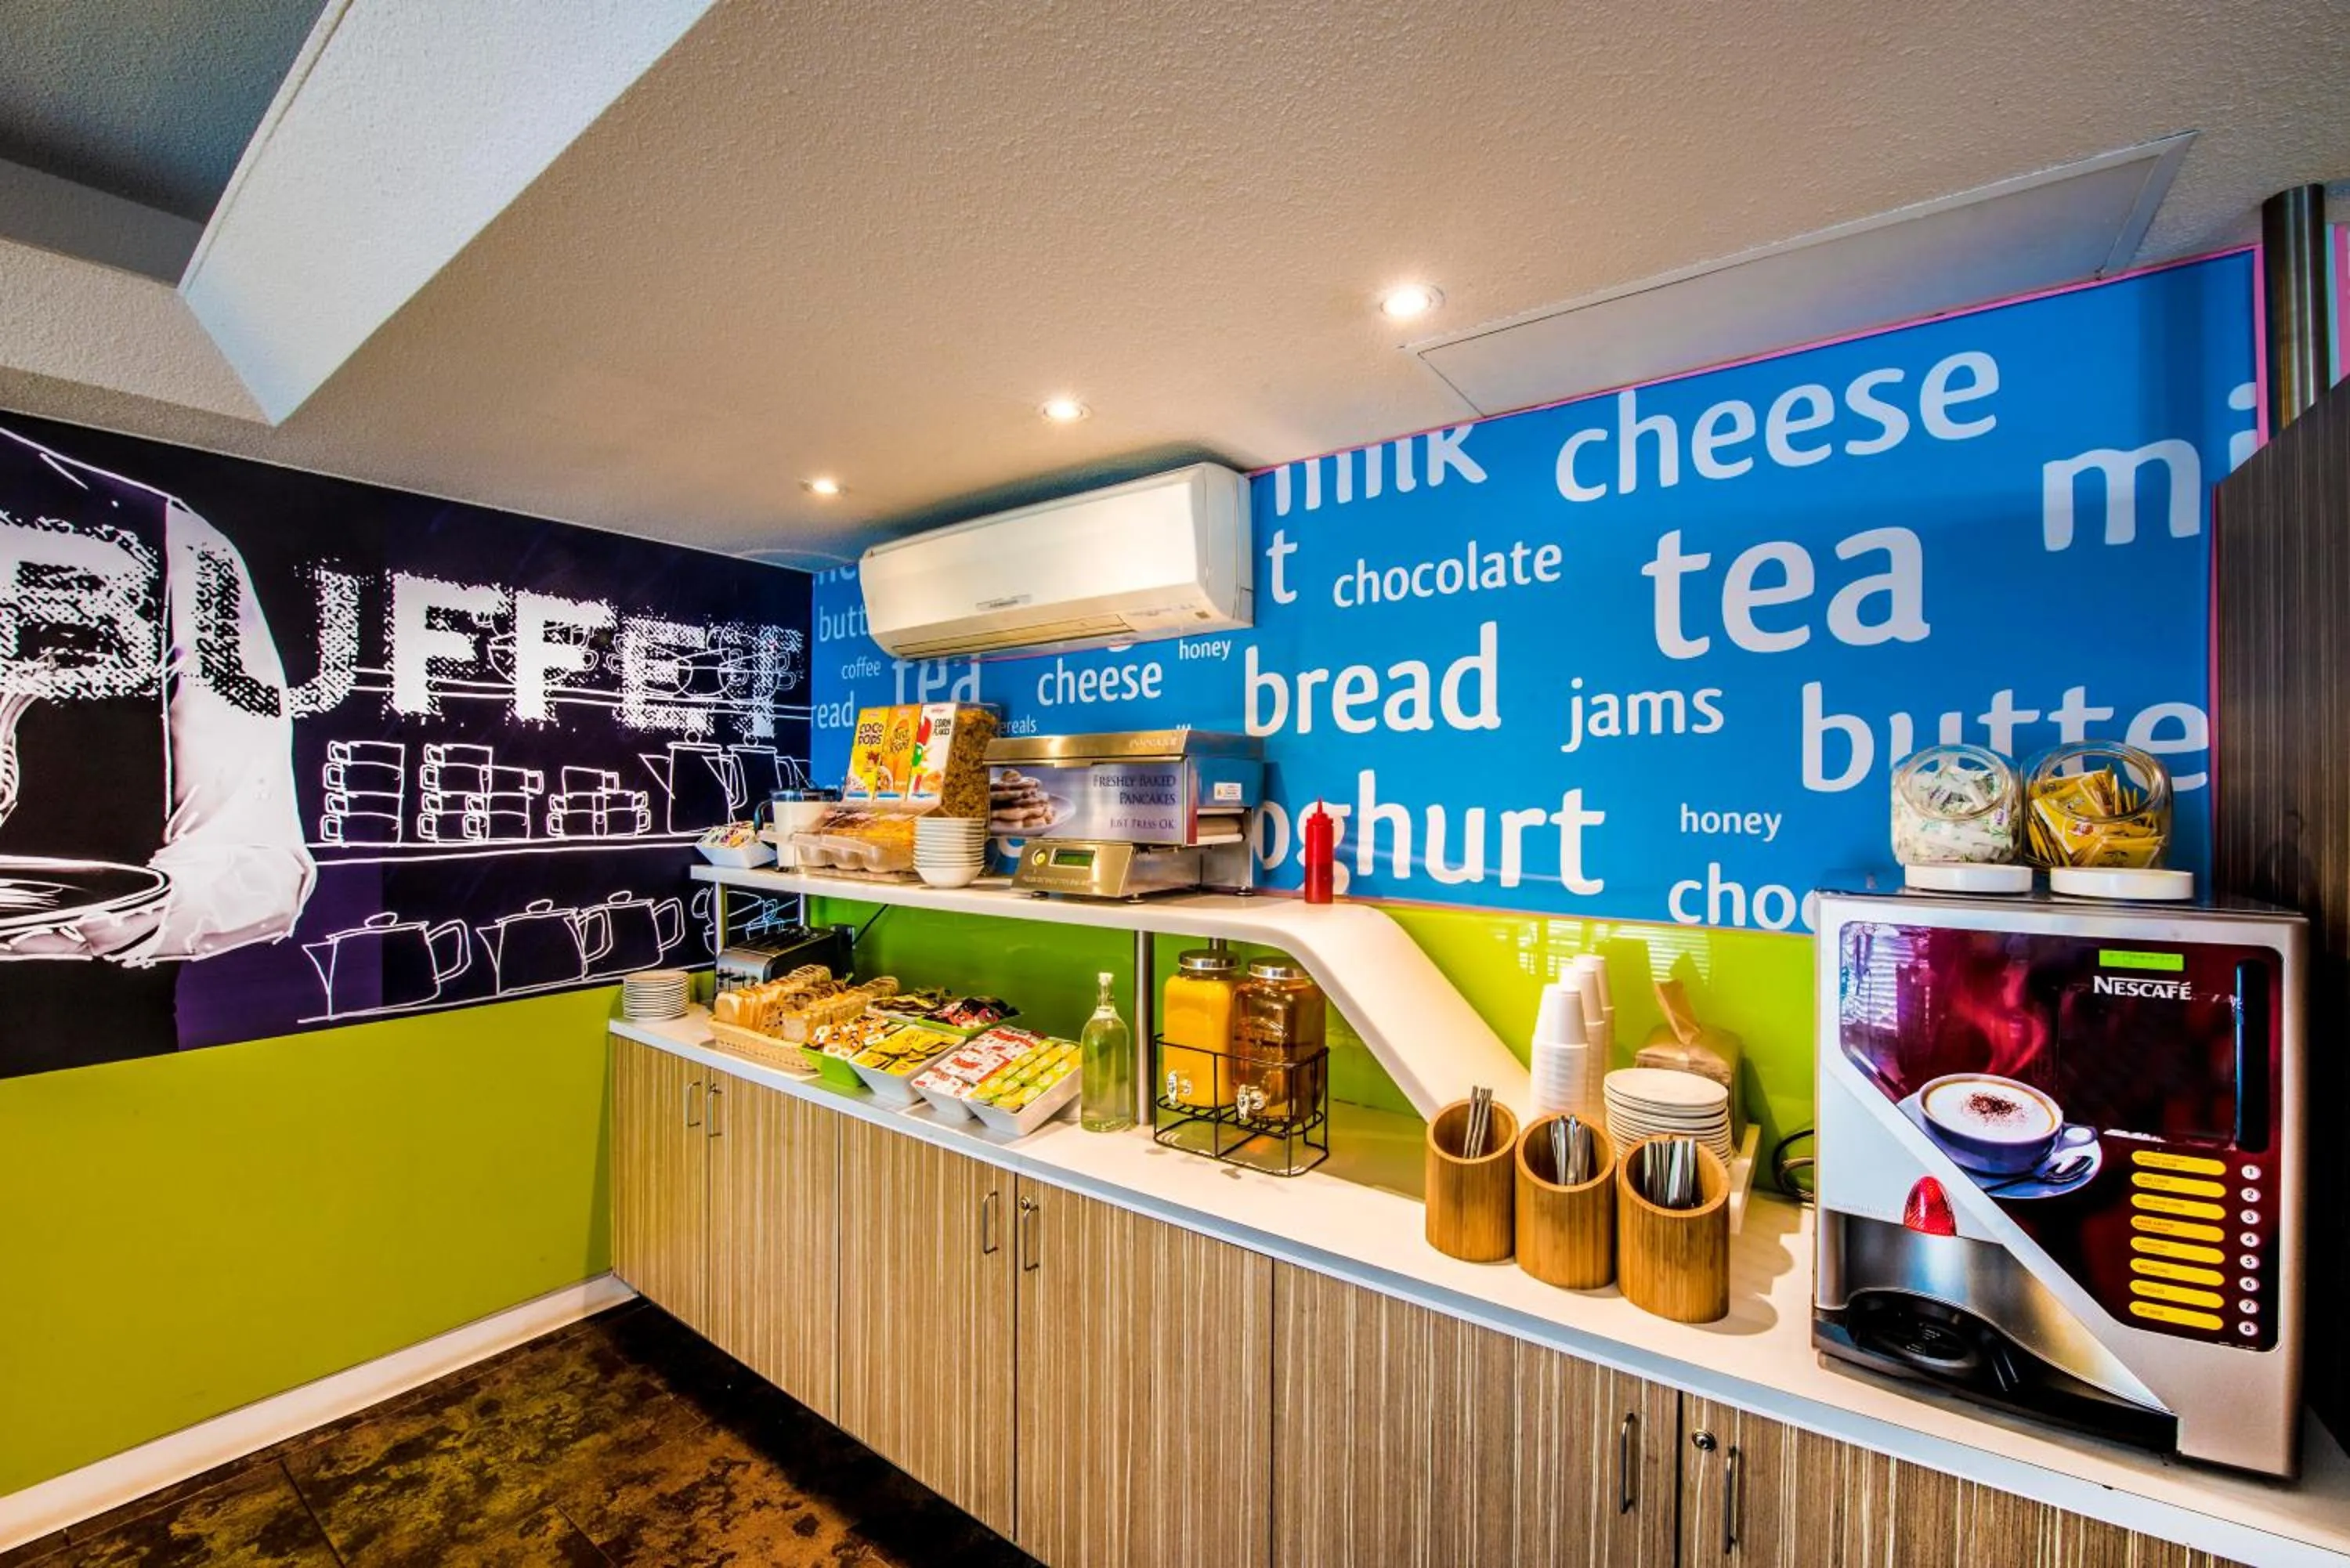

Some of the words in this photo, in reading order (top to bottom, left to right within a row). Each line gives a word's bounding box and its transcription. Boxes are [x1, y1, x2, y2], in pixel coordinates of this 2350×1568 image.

[1556, 351, 1999, 502] cheese
[1333, 540, 1563, 608] chocolate
[1641, 526, 1931, 660] tea
[0, 513, 804, 739] BUFFET
[1179, 638, 1231, 661] honey
[841, 656, 881, 680] coffee
[1244, 621, 1502, 737] bread
[1037, 657, 1163, 706] cheese
[859, 721, 884, 735] COCO
[996, 714, 1038, 734] ereals
[1560, 677, 1725, 753] jams
[858, 734, 883, 746] POPS
[1094, 775, 1135, 787] FRESHLY
[1139, 774, 1176, 787] BAKED
[1119, 792, 1176, 805] PANCAKES
[1159, 818, 1175, 829] OK
[1680, 803, 1782, 842] honey
[2093, 975, 2193, 1001] NESCAFÉ
